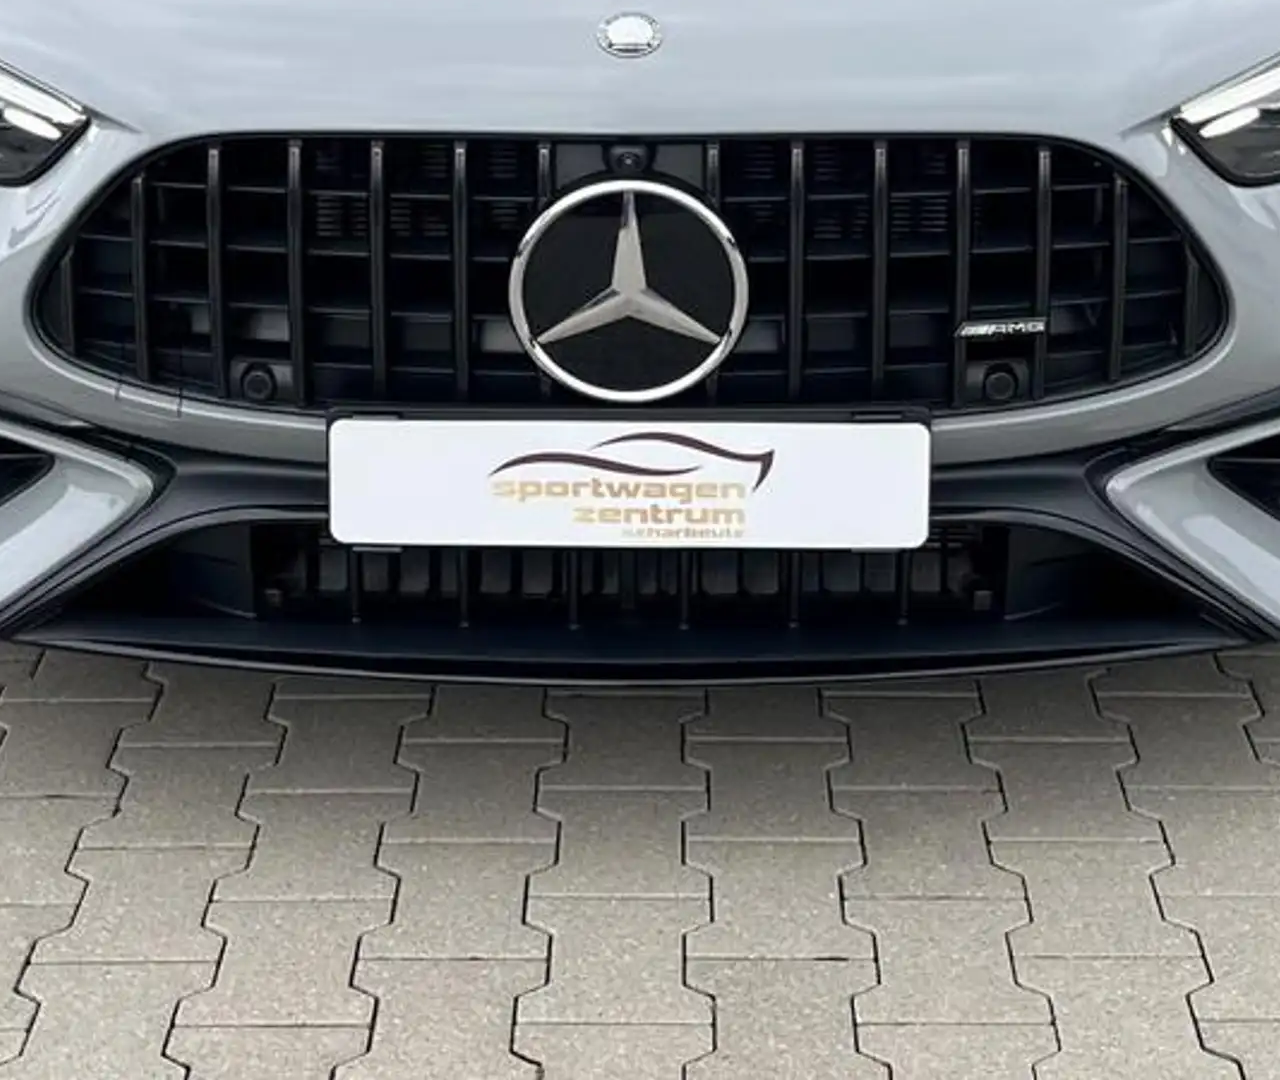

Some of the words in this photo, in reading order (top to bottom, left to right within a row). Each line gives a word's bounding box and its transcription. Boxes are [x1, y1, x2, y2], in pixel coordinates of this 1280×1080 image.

[984, 320, 1045, 335] AMG
[494, 478, 746, 502] sportwagen
[574, 504, 746, 524] zentrum
